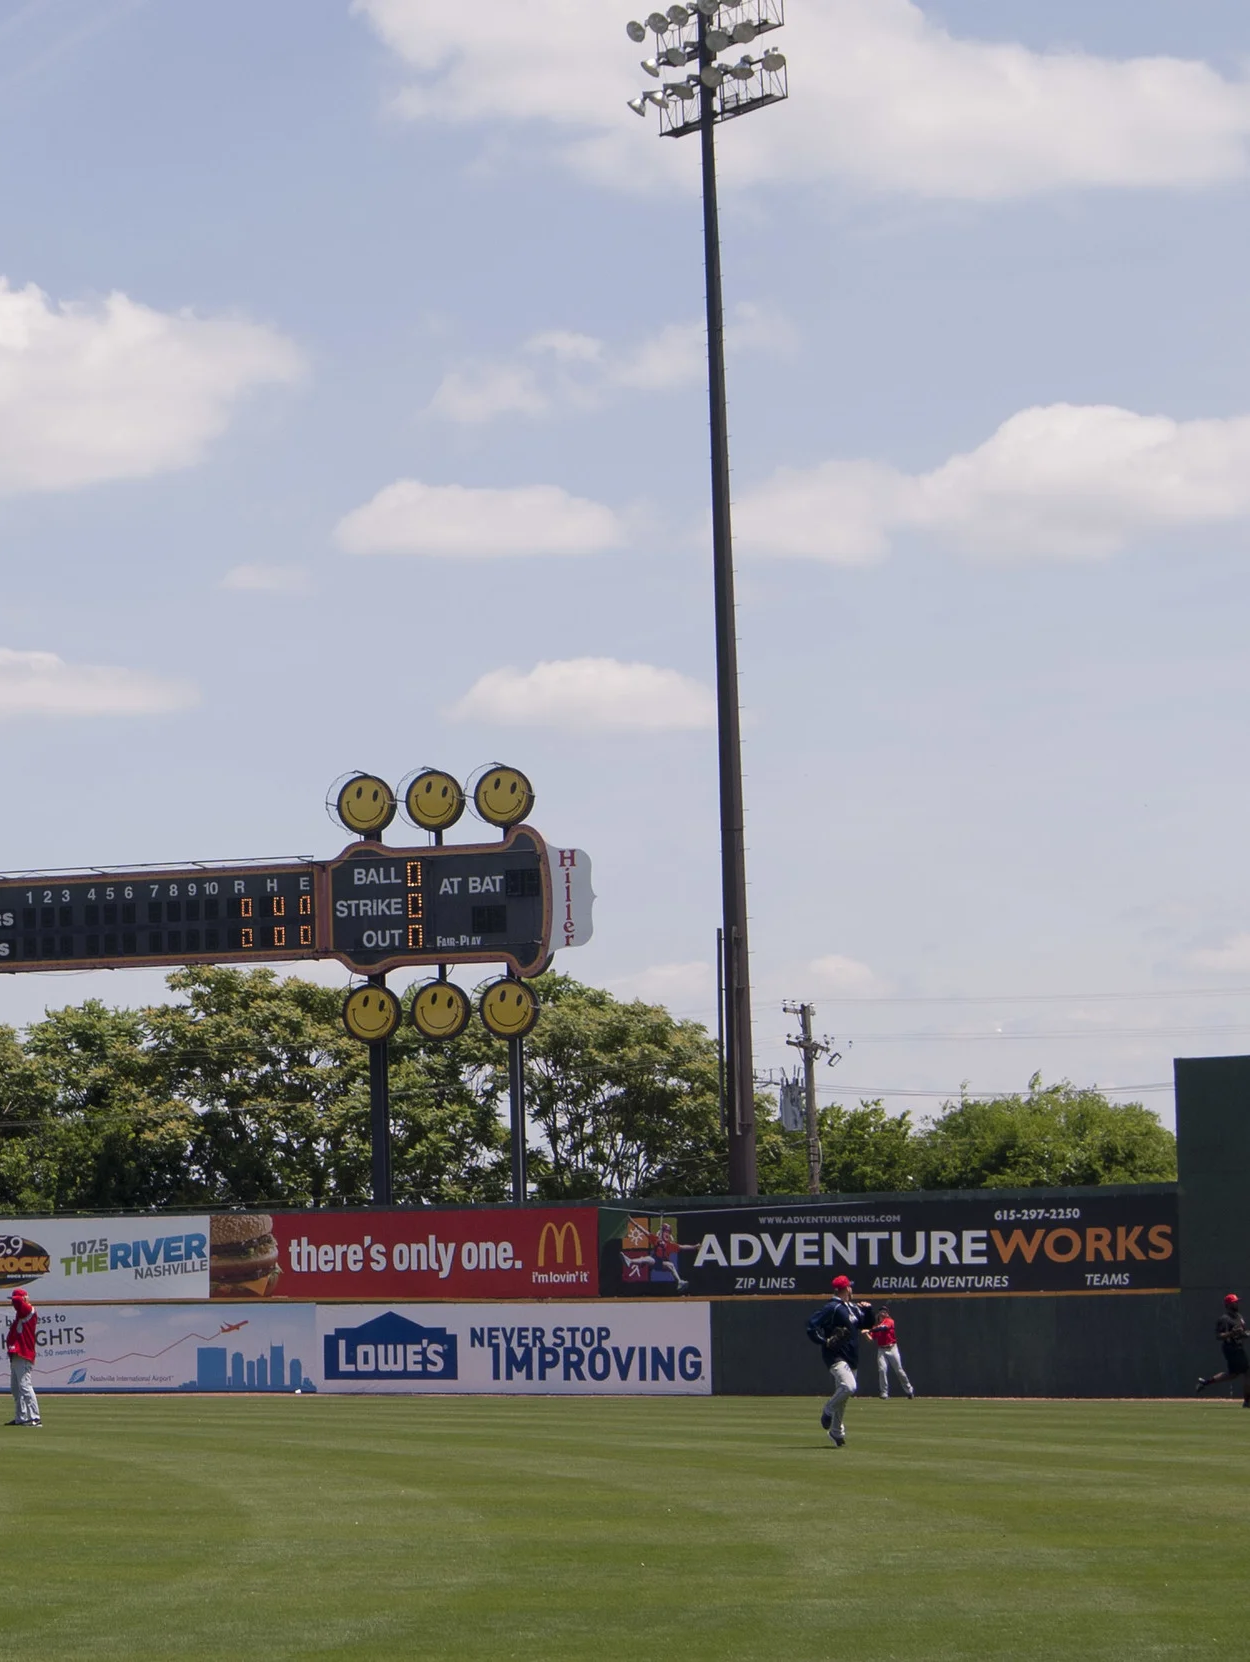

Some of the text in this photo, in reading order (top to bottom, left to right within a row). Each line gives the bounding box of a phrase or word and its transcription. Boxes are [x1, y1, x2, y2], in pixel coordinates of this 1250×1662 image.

[353, 866, 402, 885] BALL
[439, 875, 504, 895] AT BAT
[26, 877, 310, 904] 1 2 3 4 5 6 7 8 9 10 R H E
[558, 849, 577, 947] Hiller
[335, 898, 403, 917] STRIKE
[362, 929, 403, 947] OUT
[758, 1208, 1081, 1224] WWW.ADVENTUREWORKS.COM 615-297-2250
[60, 1232, 207, 1277] THE RIVER
[70, 1238, 108, 1256] 107.5
[288, 1234, 523, 1278] there's only one.
[134, 1259, 209, 1281] NASHVILLE
[531, 1271, 549, 1284] i'm
[579, 1270, 589, 1283] it
[1085, 1273, 1130, 1286] TEAMS
[735, 1277, 796, 1289] ZIP LINES
[872, 1275, 1009, 1290] AERIAL ADVENTURES
[55, 1313, 66, 1323] to
[470, 1326, 610, 1348] NEVER STOP
[338, 1338, 445, 1373] LOWE'S
